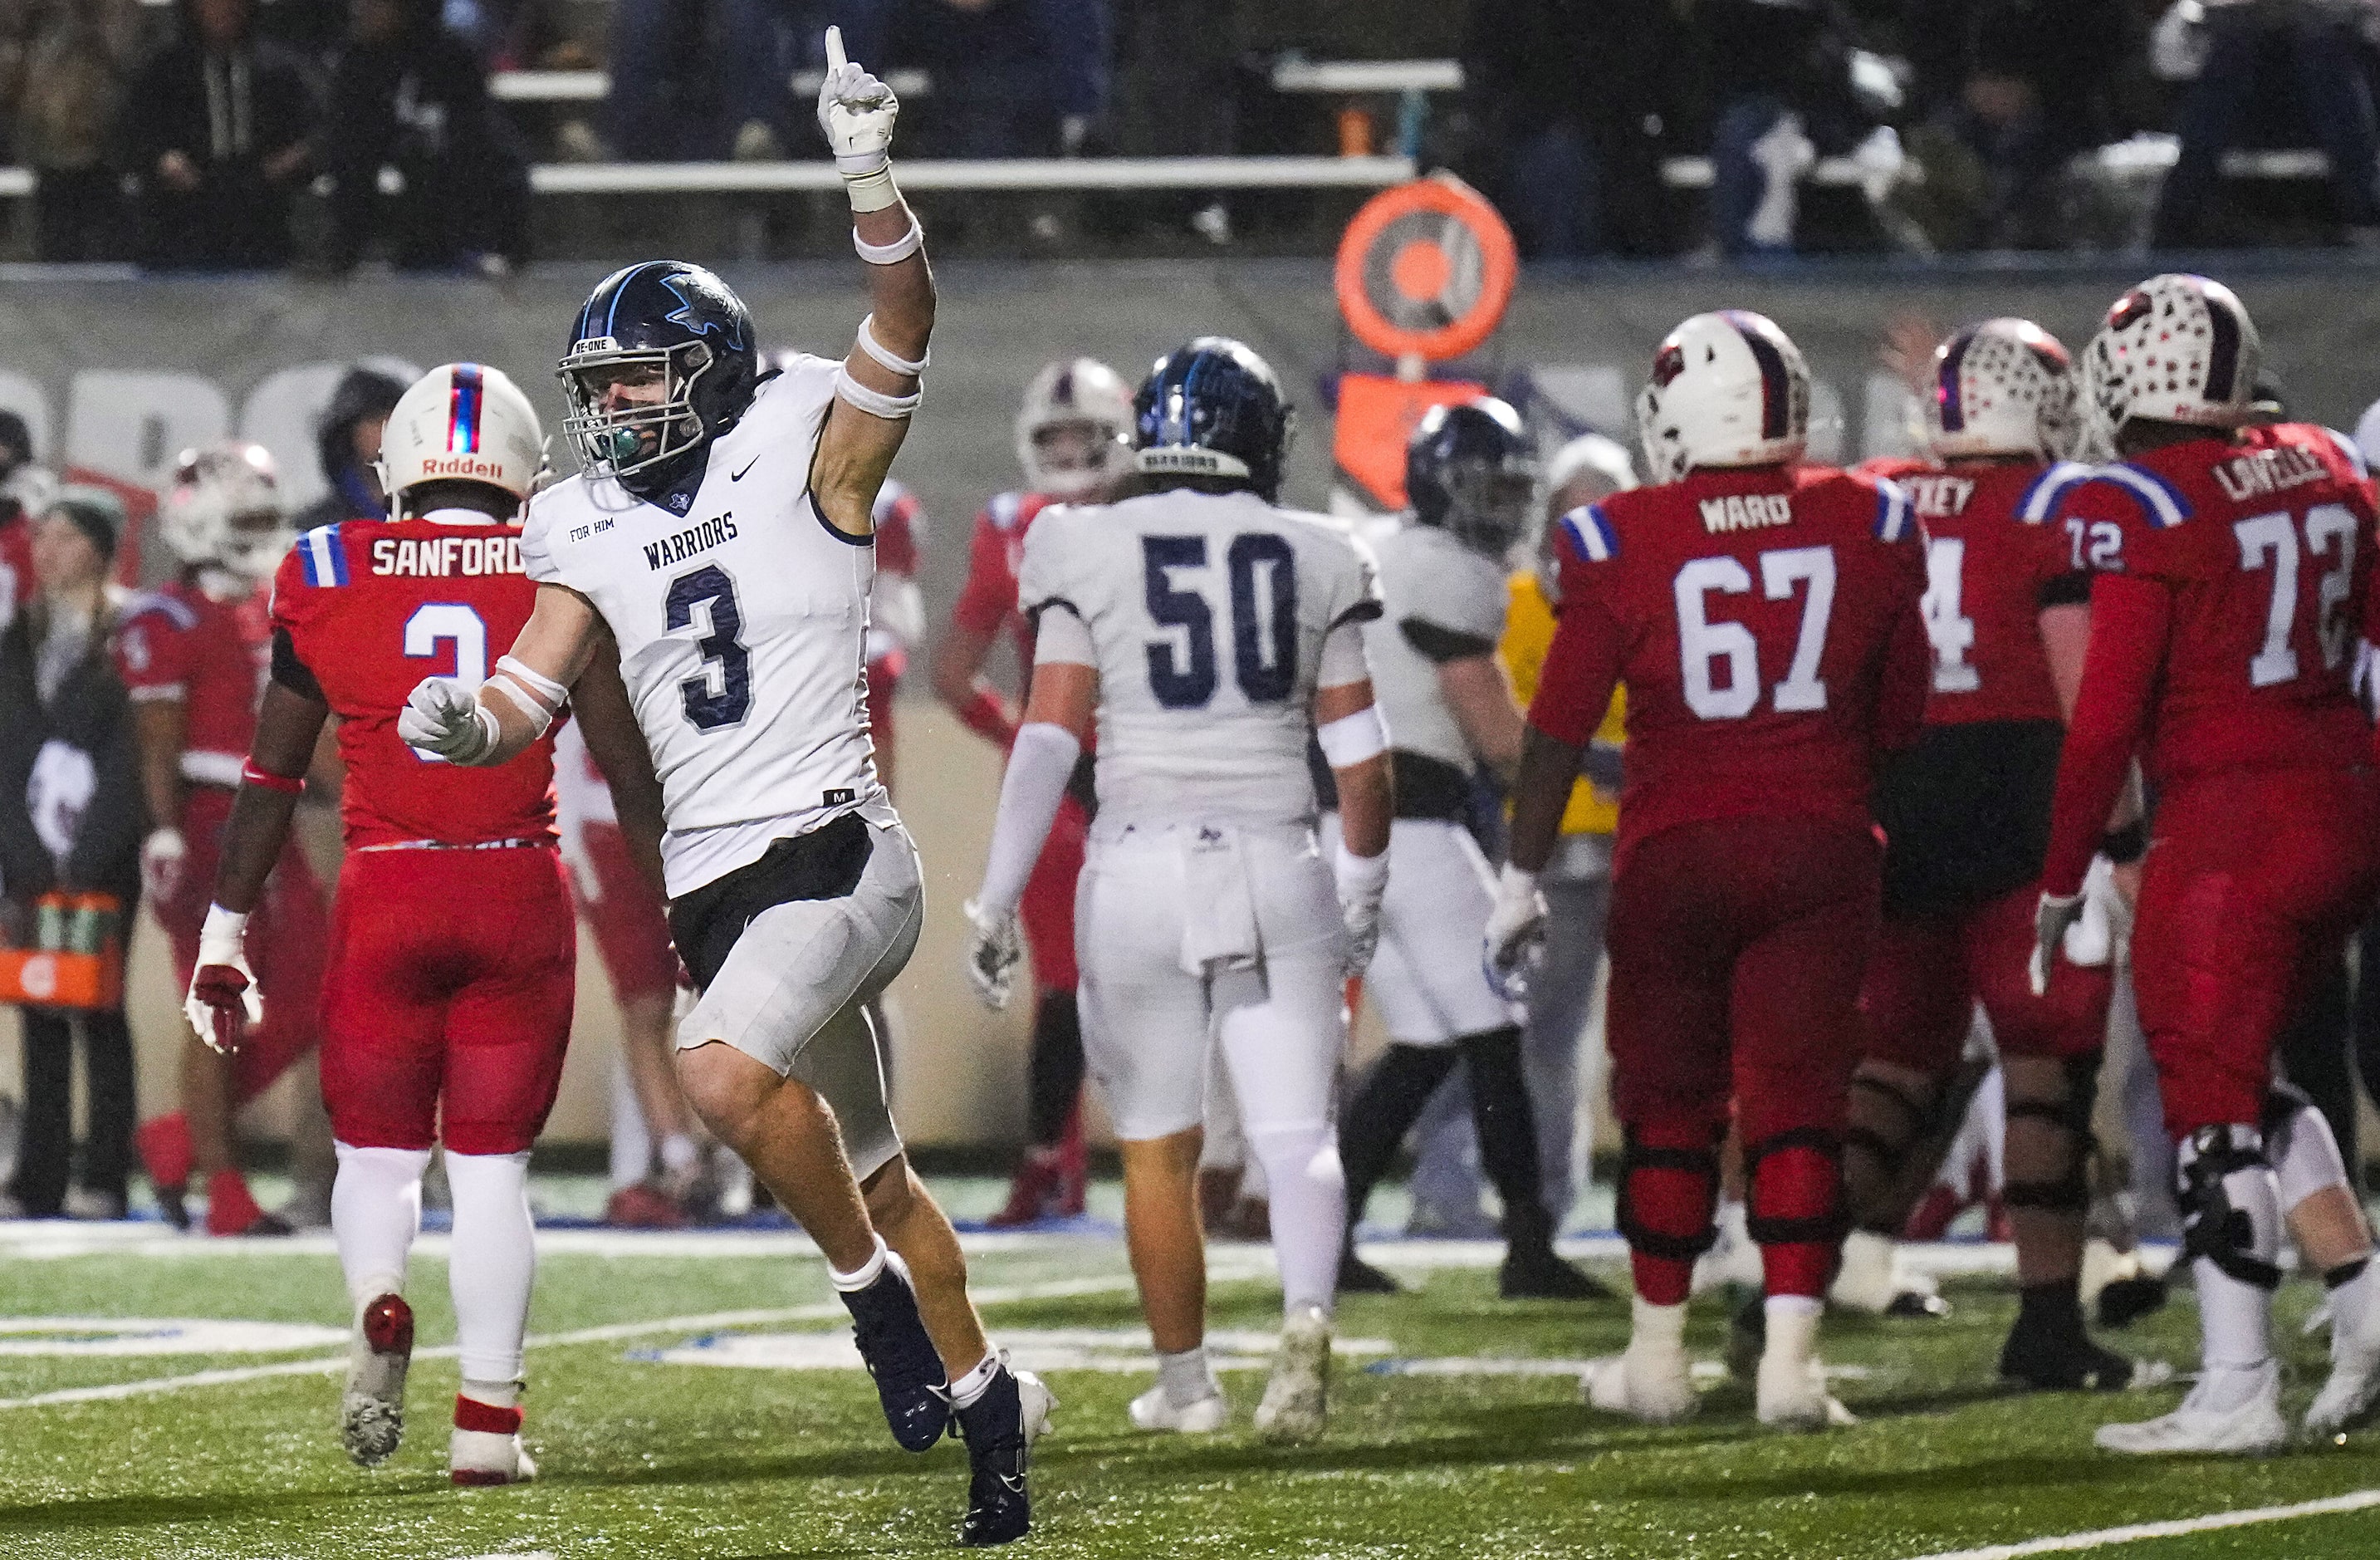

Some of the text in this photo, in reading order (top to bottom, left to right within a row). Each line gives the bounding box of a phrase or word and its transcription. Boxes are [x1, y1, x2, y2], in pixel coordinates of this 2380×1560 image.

[576, 340, 607, 353] BE-ONE
[422, 458, 503, 479] Riddell
[570, 517, 615, 542] FOR HIM
[1699, 493, 1792, 534] WARD
[372, 537, 526, 577] SANFORD
[642, 511, 738, 571] WARRIORS
[2231, 503, 2359, 688] 72
[1140, 533, 1295, 710] 50
[1673, 546, 1838, 721] 67
[662, 558, 756, 736] 3
